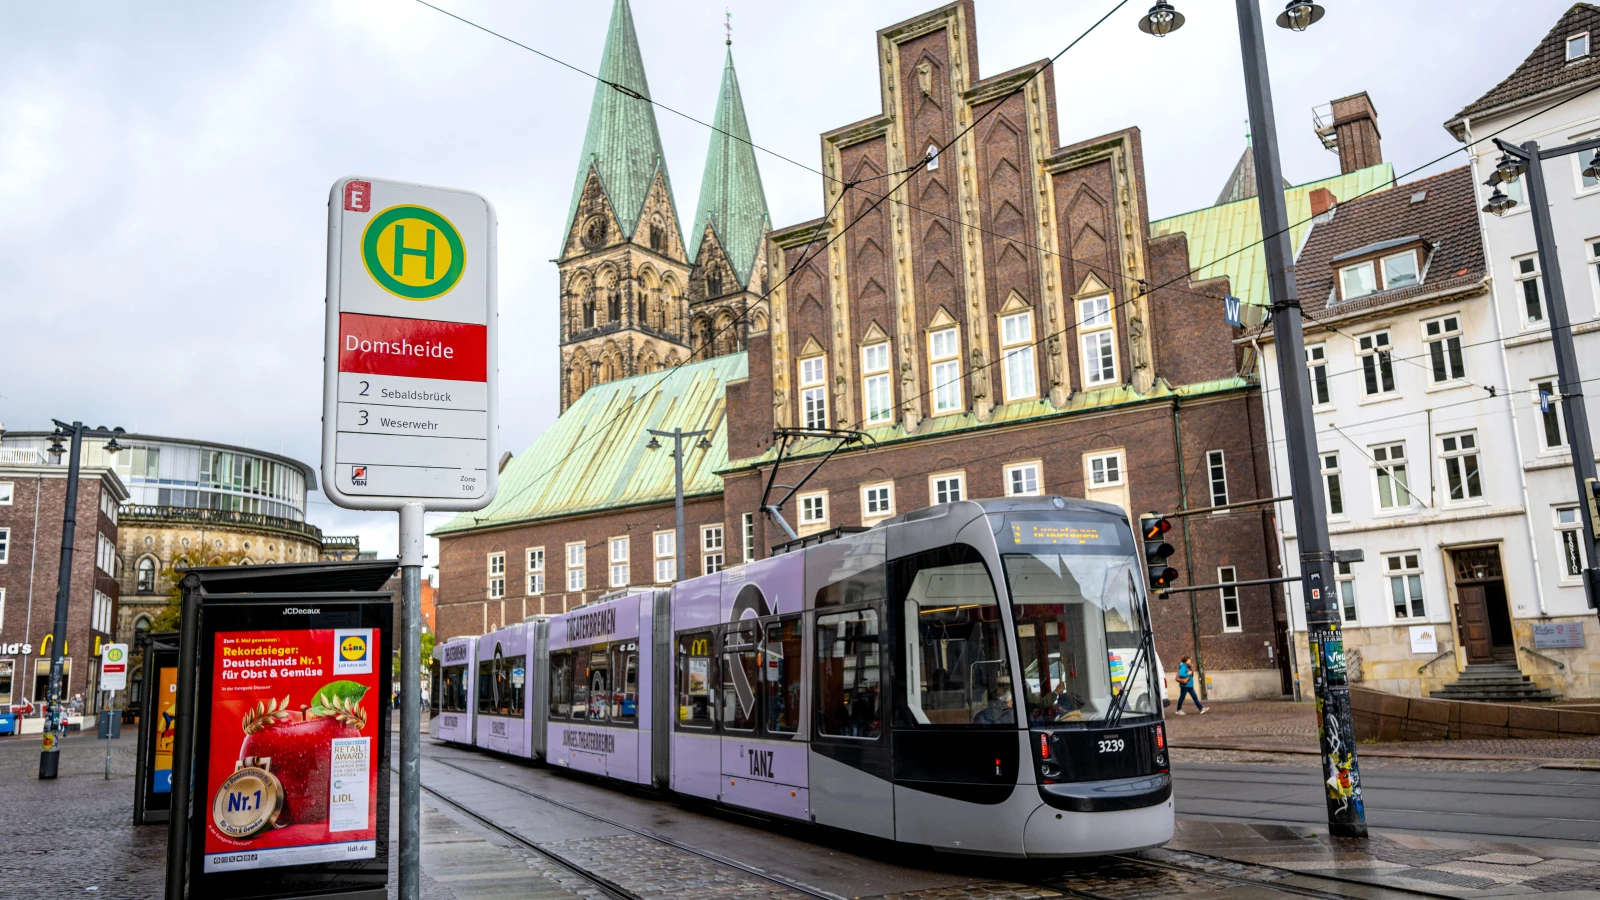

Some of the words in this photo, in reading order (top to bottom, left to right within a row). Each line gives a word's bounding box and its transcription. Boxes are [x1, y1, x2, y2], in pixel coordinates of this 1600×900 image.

[351, 190, 363, 208] E
[393, 224, 436, 280] H
[1225, 298, 1240, 322] W
[345, 334, 454, 359] Domsheide
[358, 380, 370, 397] 2
[381, 388, 452, 402] Sebaldsbrück
[1541, 395, 1548, 408] W
[357, 409, 369, 426] 3
[380, 417, 438, 430] Weserwehr
[460, 475, 477, 483] Zone
[282, 607, 321, 615] JCDecaux
[566, 607, 616, 642] THEATERBREMEN
[0, 643, 32, 655] ld's
[223, 645, 299, 657] Rekordsieger:
[222, 657, 297, 668] Deutschlands
[299, 657, 315, 666] Nr.
[316, 656, 322, 665] 1
[222, 669, 239, 680] für
[241, 669, 268, 679] Obst
[269, 669, 278, 678] &
[280, 667, 323, 678] Gemüse
[334, 745, 363, 754] RETAIL
[1098, 739, 1125, 753] 3239
[334, 752, 364, 761] AWARD
[748, 748, 774, 779] TANZ
[332, 793, 354, 803] LIDL
[347, 844, 368, 852] lidl.de
